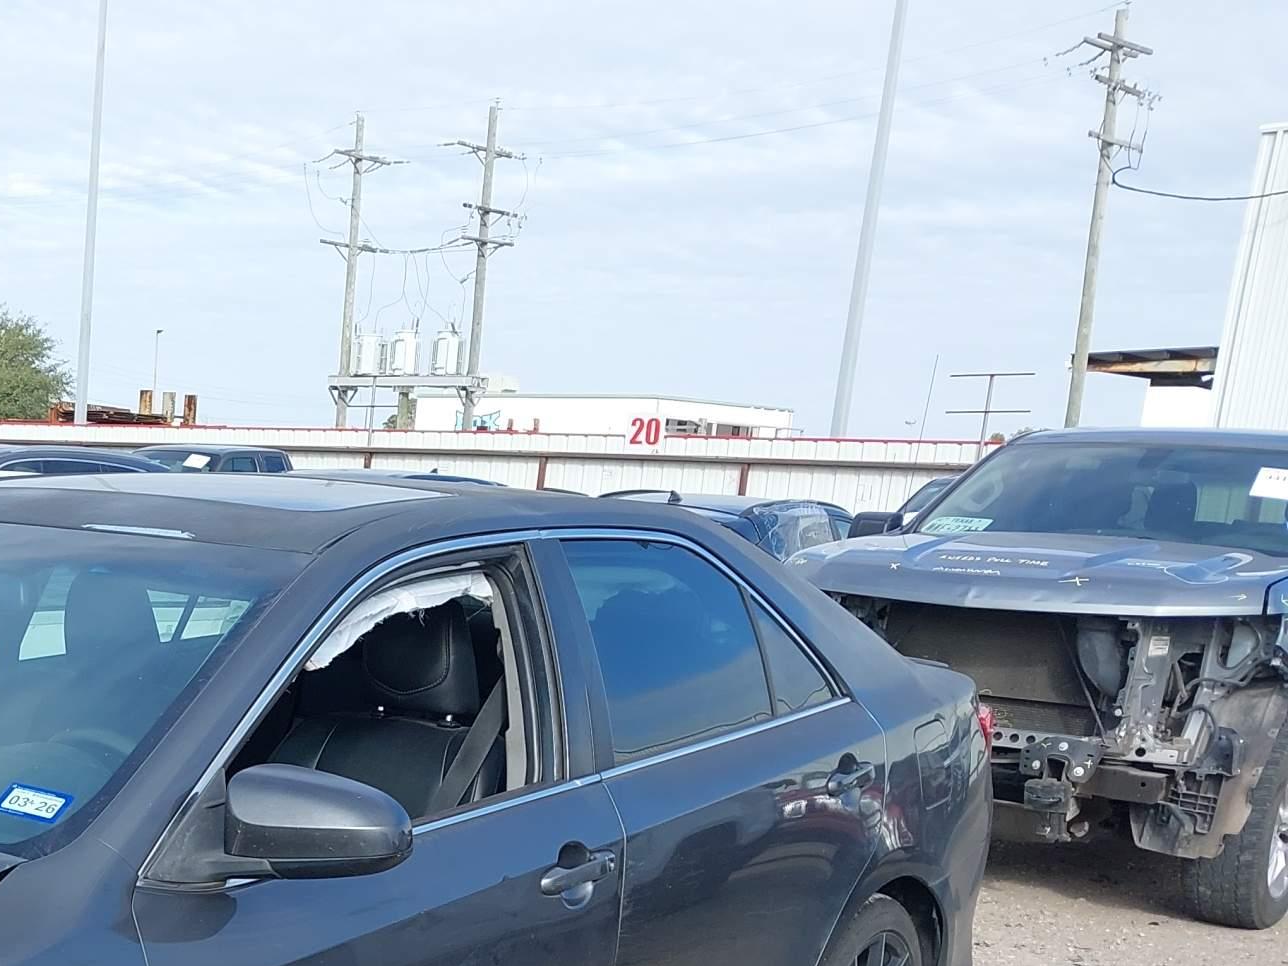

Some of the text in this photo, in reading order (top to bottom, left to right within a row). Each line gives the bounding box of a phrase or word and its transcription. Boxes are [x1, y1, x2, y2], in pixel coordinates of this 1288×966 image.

[629, 417, 661, 445] 20
[8, 795, 30, 808] 03
[34, 801, 58, 814] 26
